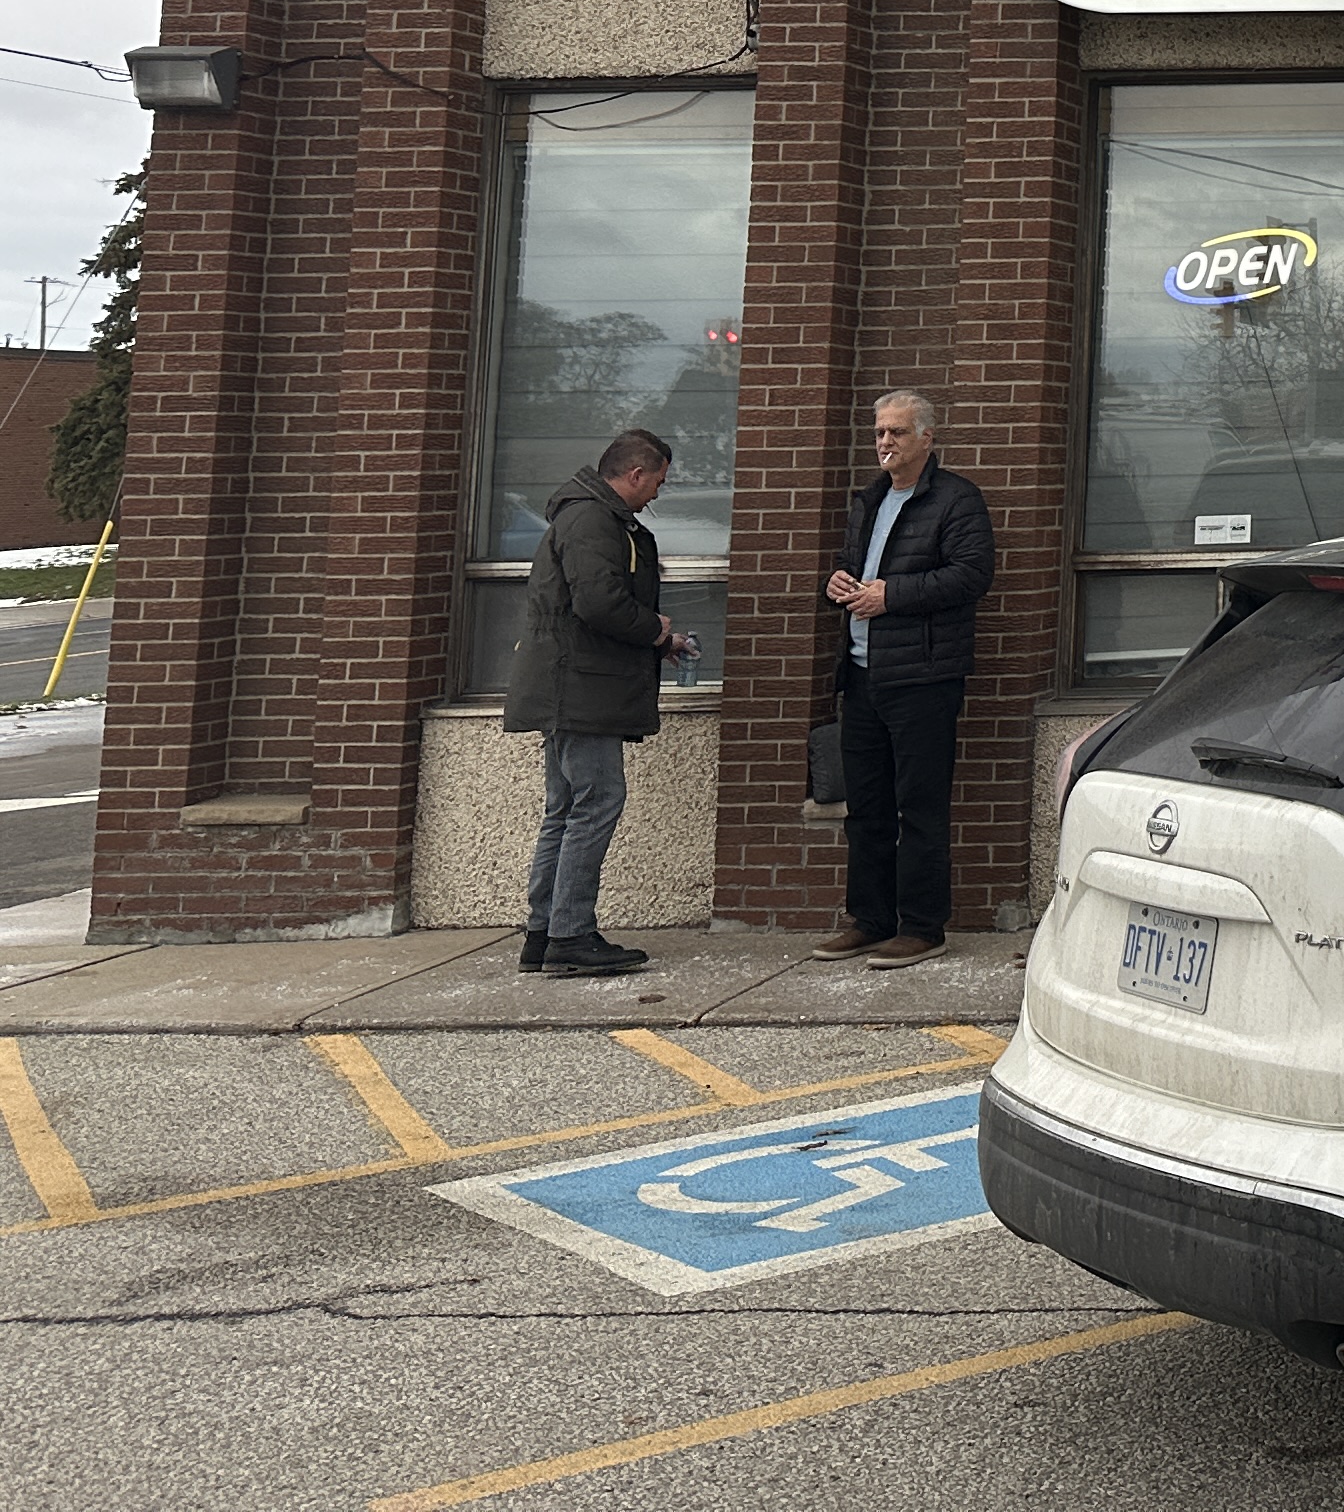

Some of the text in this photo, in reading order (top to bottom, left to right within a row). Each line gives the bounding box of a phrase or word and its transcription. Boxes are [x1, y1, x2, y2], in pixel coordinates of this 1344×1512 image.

[1176, 243, 1299, 291] OPEN
[1152, 910, 1189, 931] ONTARIO
[1123, 923, 1208, 987] DFTV 137
